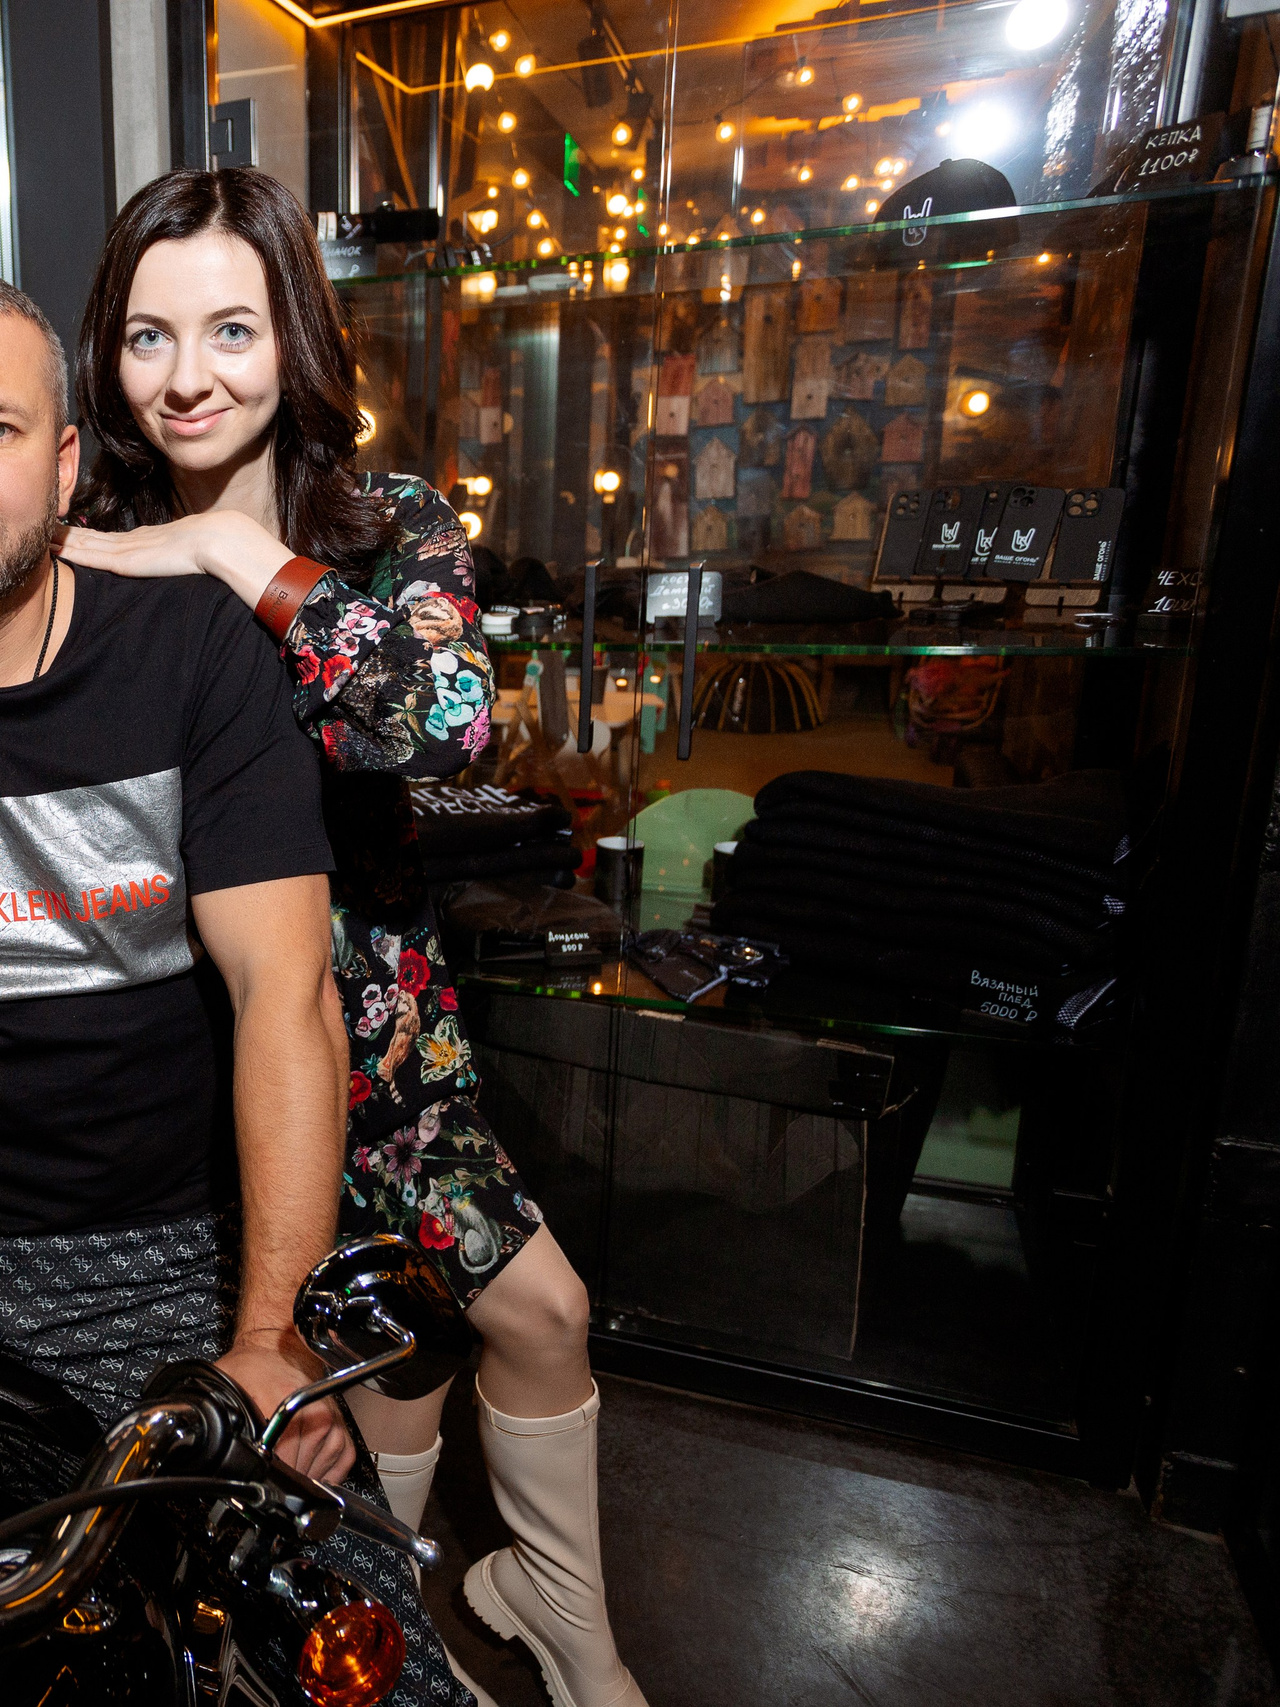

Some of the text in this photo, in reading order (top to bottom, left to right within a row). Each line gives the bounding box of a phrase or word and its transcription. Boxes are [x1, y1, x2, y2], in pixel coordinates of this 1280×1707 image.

[1145, 125, 1201, 149] КЕПКА
[1157, 570, 1204, 586] ЧЕХО
[75, 874, 170, 922] JEANS
[980, 1001, 1018, 1019] 5000
